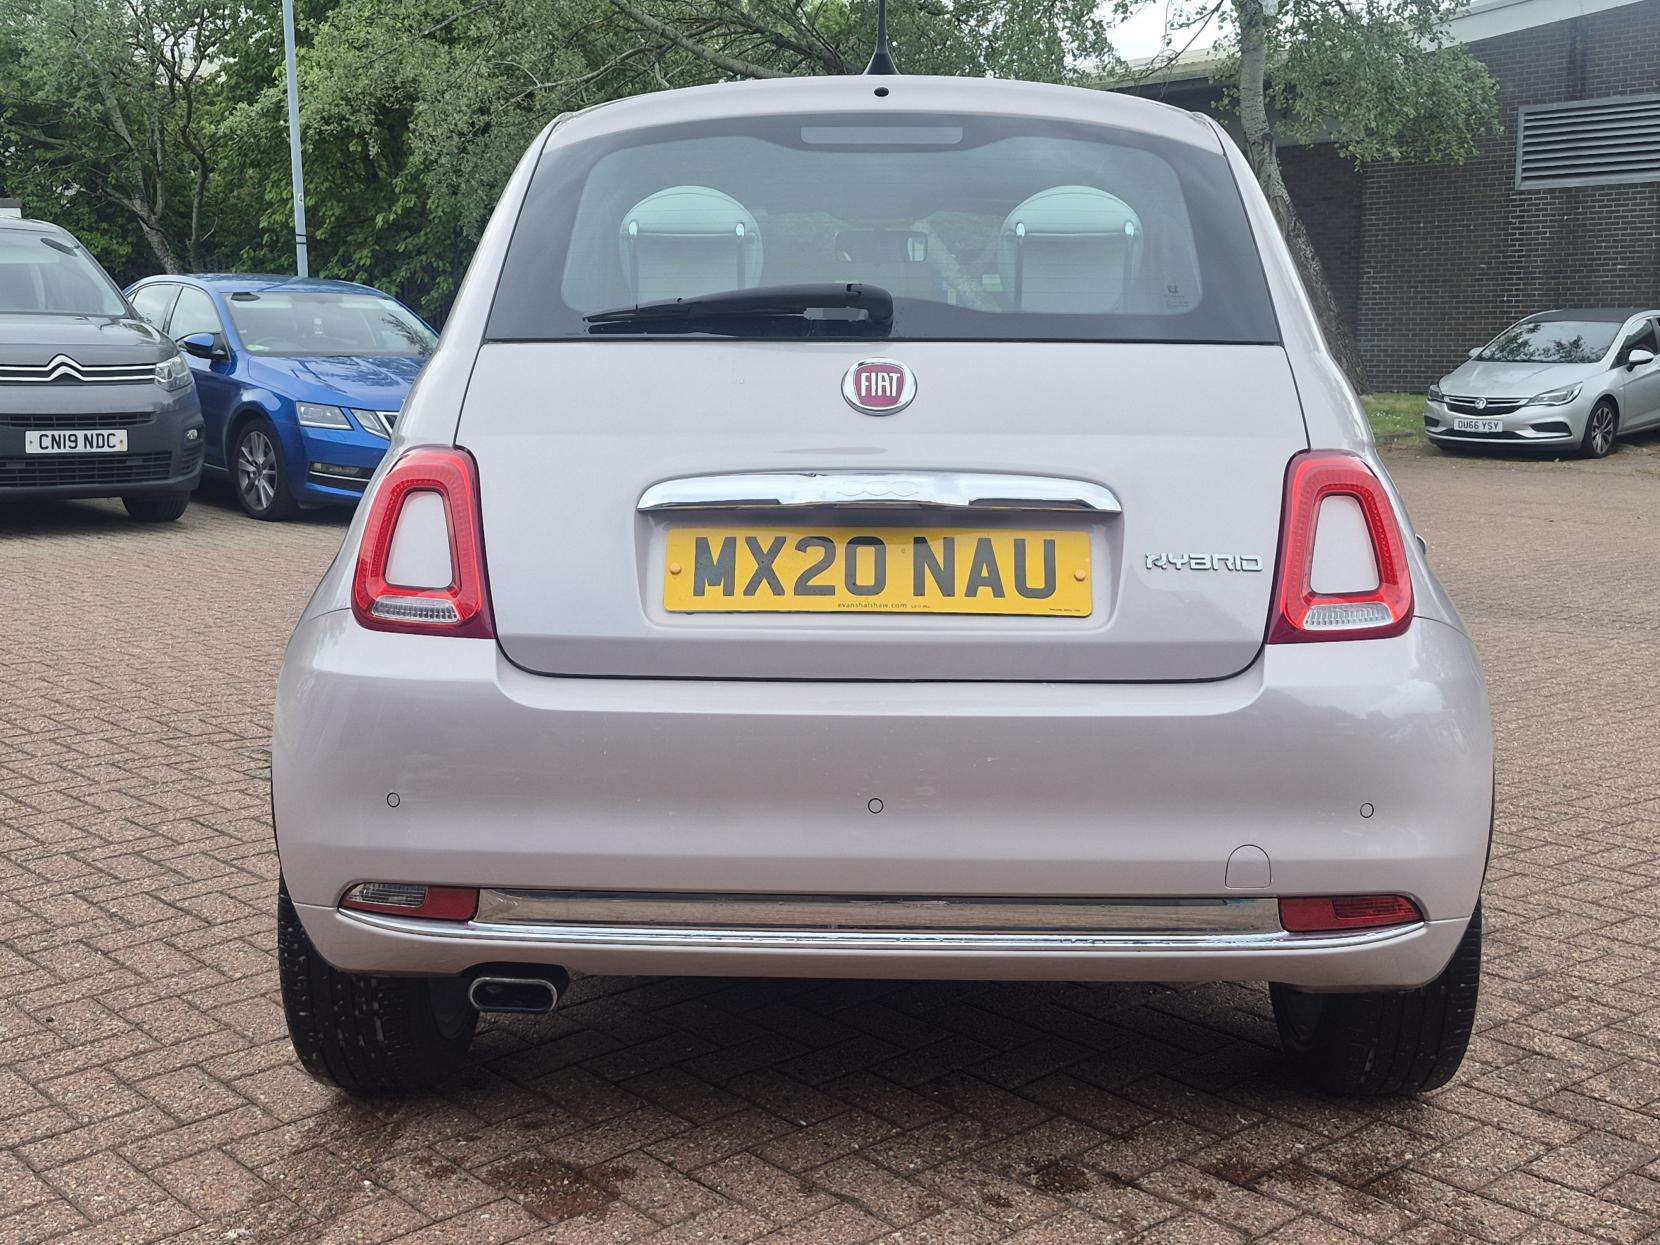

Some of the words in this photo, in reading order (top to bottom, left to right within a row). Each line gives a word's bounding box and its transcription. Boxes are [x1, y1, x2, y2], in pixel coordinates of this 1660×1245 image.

[860, 372, 901, 397] FIAT
[1481, 421, 1499, 431] YSY
[38, 433, 79, 450] CN19
[83, 432, 117, 449] NDC
[692, 535, 887, 597] MX20
[912, 535, 1057, 600] NAU
[1145, 552, 1264, 572] HYBRID
